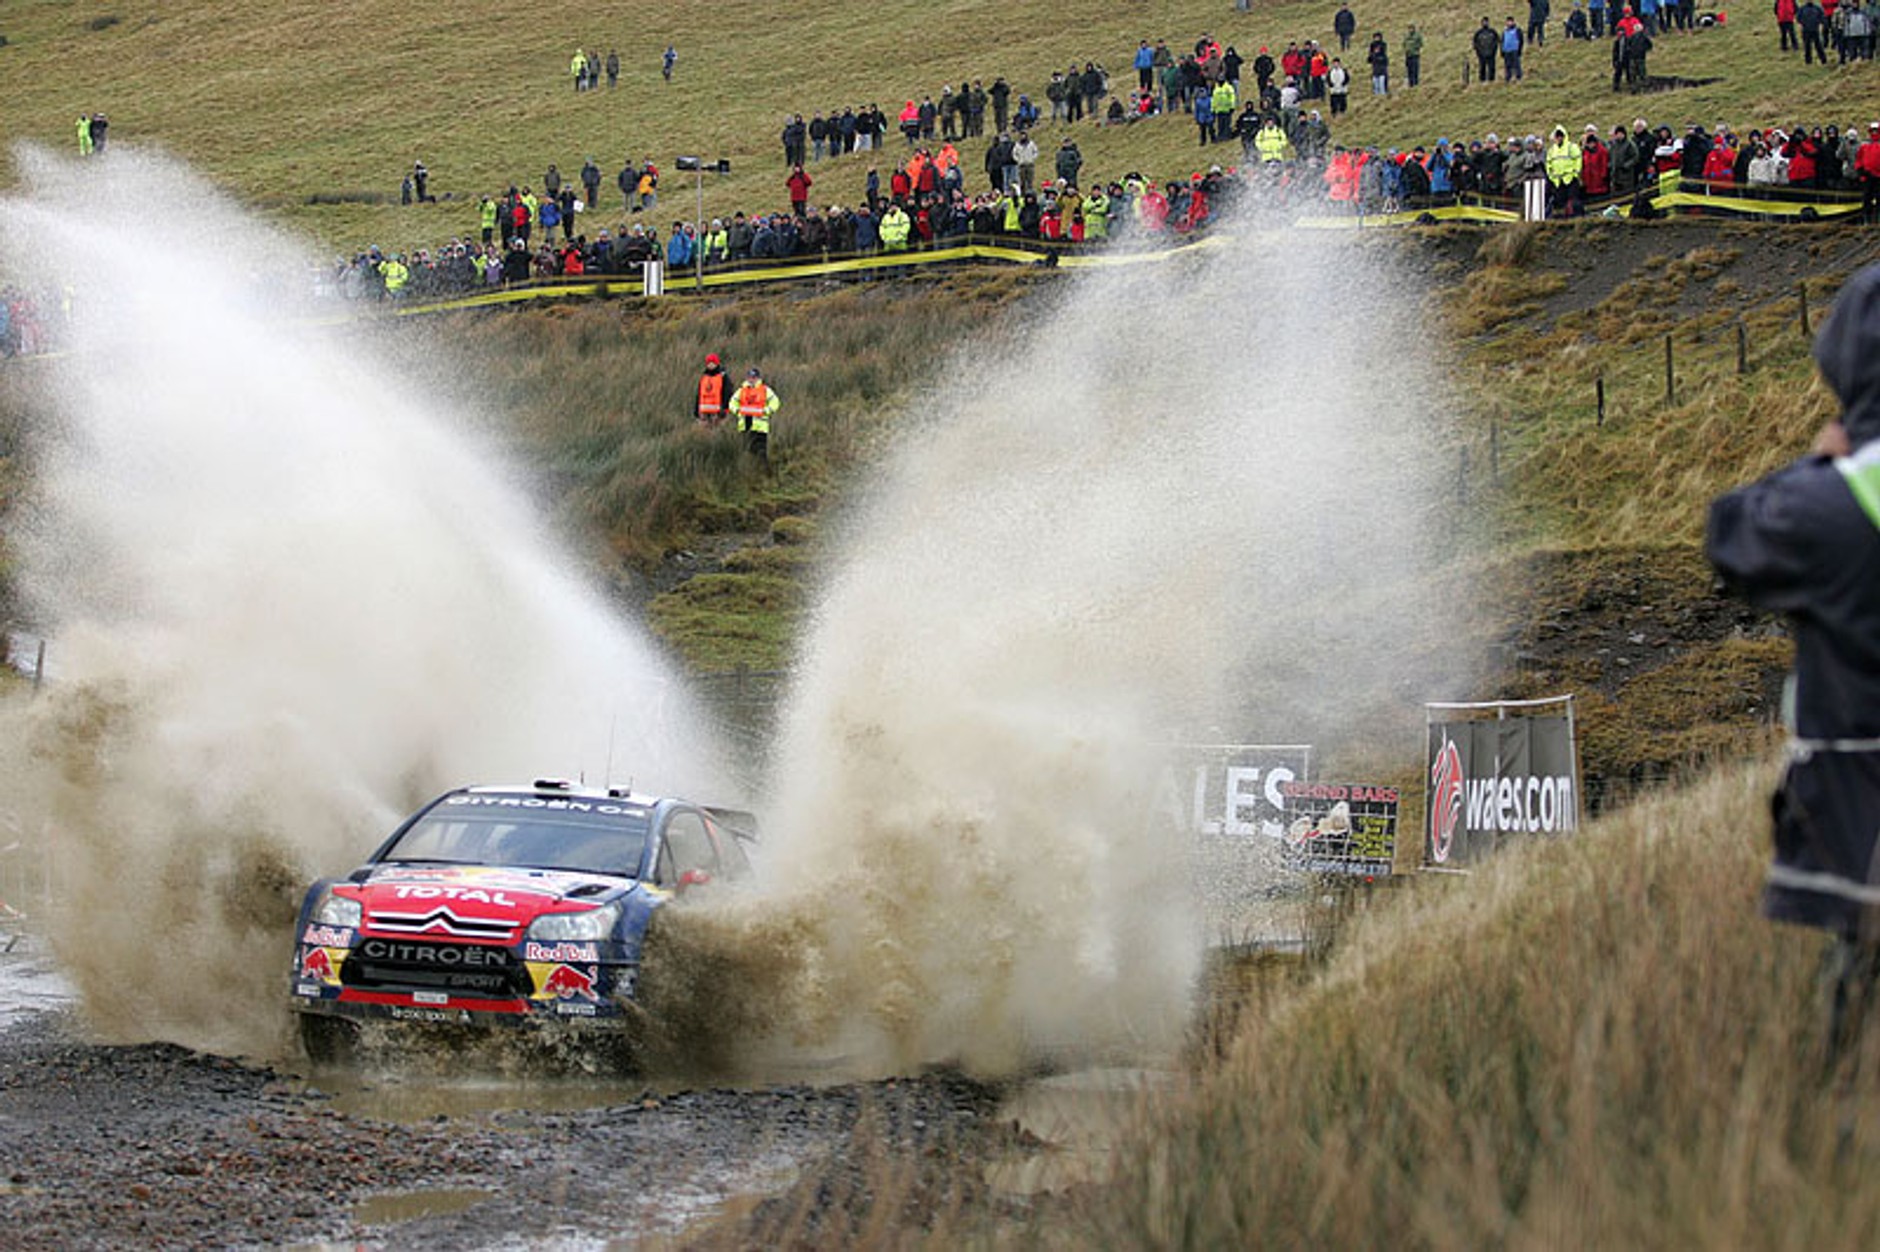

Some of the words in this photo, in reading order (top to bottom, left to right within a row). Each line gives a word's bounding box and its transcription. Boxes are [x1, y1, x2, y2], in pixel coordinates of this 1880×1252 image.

[1351, 787, 1398, 802] BARS
[395, 885, 516, 907] TOTAL
[364, 941, 507, 965] CITROËN
[450, 975, 504, 987] SPORT
